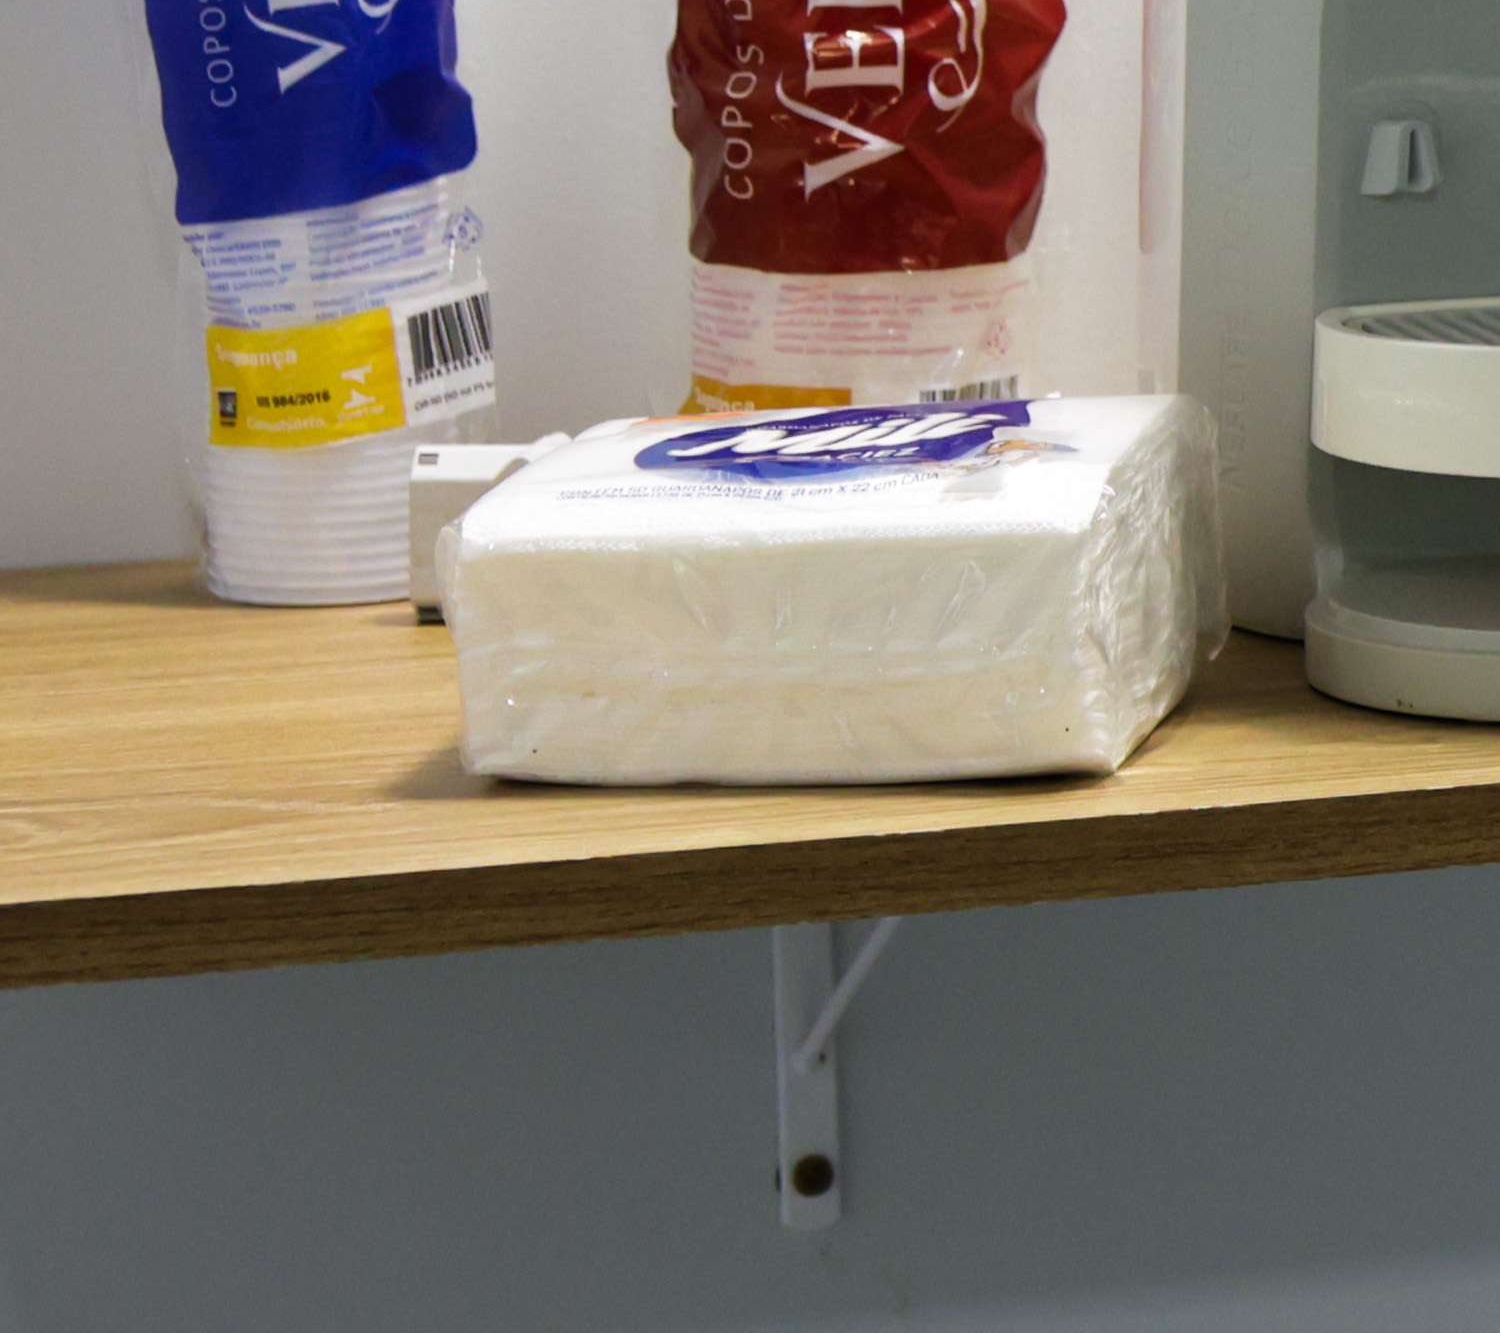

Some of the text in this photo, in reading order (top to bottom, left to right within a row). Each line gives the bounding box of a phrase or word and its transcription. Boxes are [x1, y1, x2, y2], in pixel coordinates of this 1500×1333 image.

[720, 44, 765, 200] COPOS
[650, 484, 763, 497] GUARDANAPOS
[808, 488, 833, 496] cm
[852, 483, 871, 493] 22
[873, 480, 898, 492] cm
[901, 471, 940, 487] CADA
